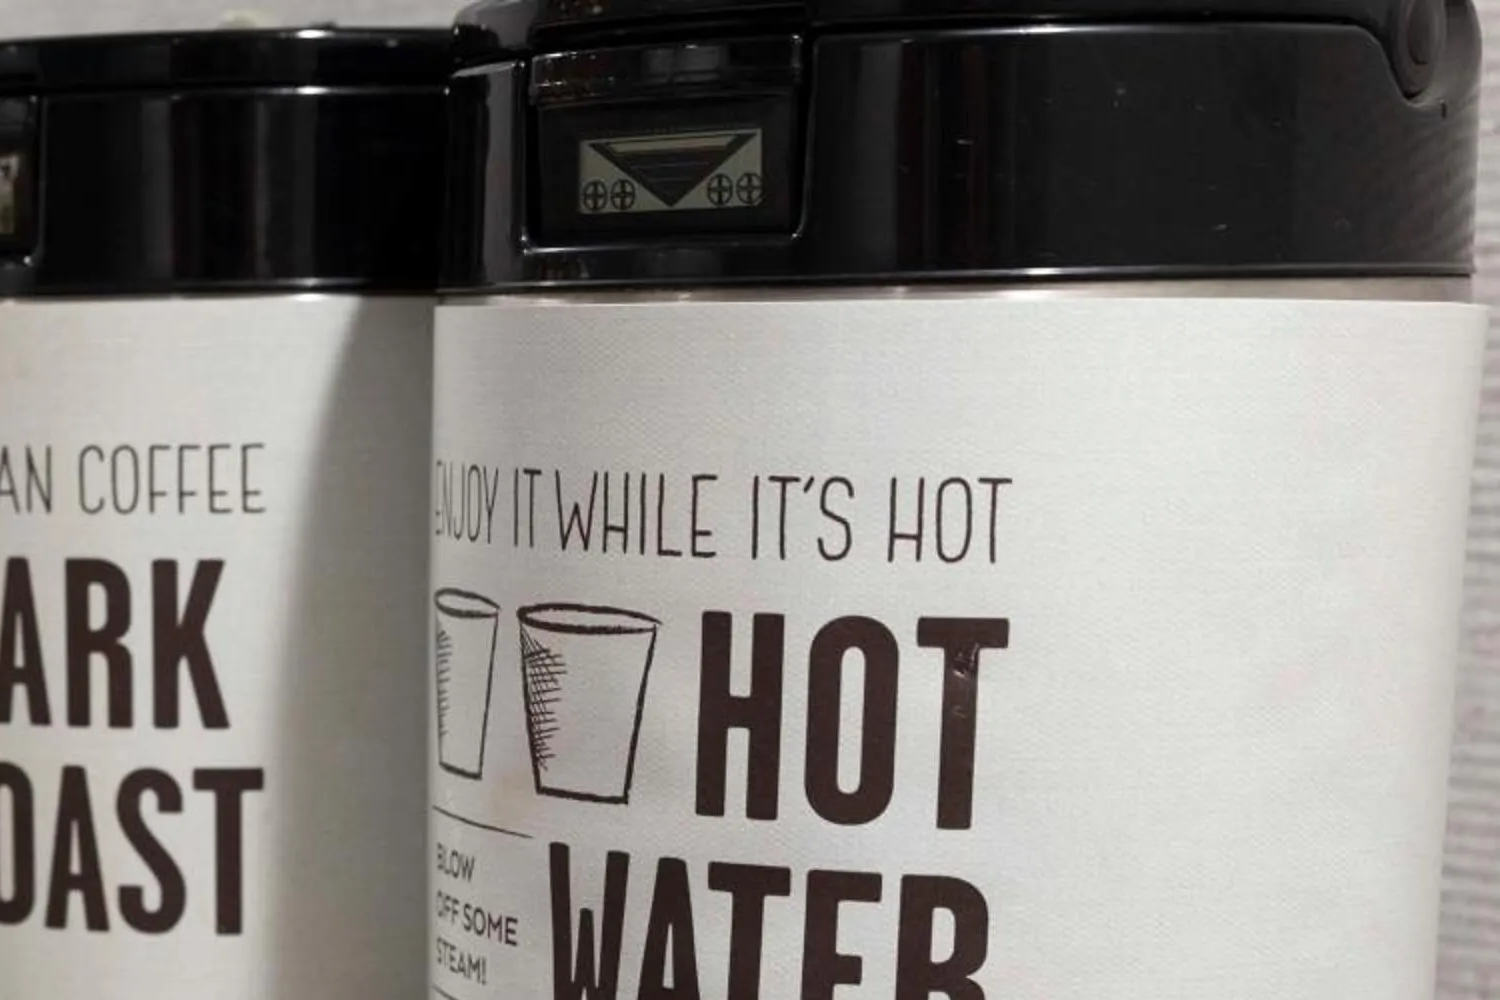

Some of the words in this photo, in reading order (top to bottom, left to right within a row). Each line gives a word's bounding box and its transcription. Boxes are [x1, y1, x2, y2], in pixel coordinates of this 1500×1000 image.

[78, 443, 267, 515] COFFEE
[513, 467, 542, 548] IT
[555, 469, 718, 558] WHILE
[751, 475, 854, 562] IT'S
[887, 477, 1013, 564] HOT
[695, 610, 1010, 830] HOT
[437, 842, 475, 882] BLOW
[436, 890, 460, 925] OFF
[463, 903, 519, 947] SOME
[437, 936, 487, 986] STEAM!
